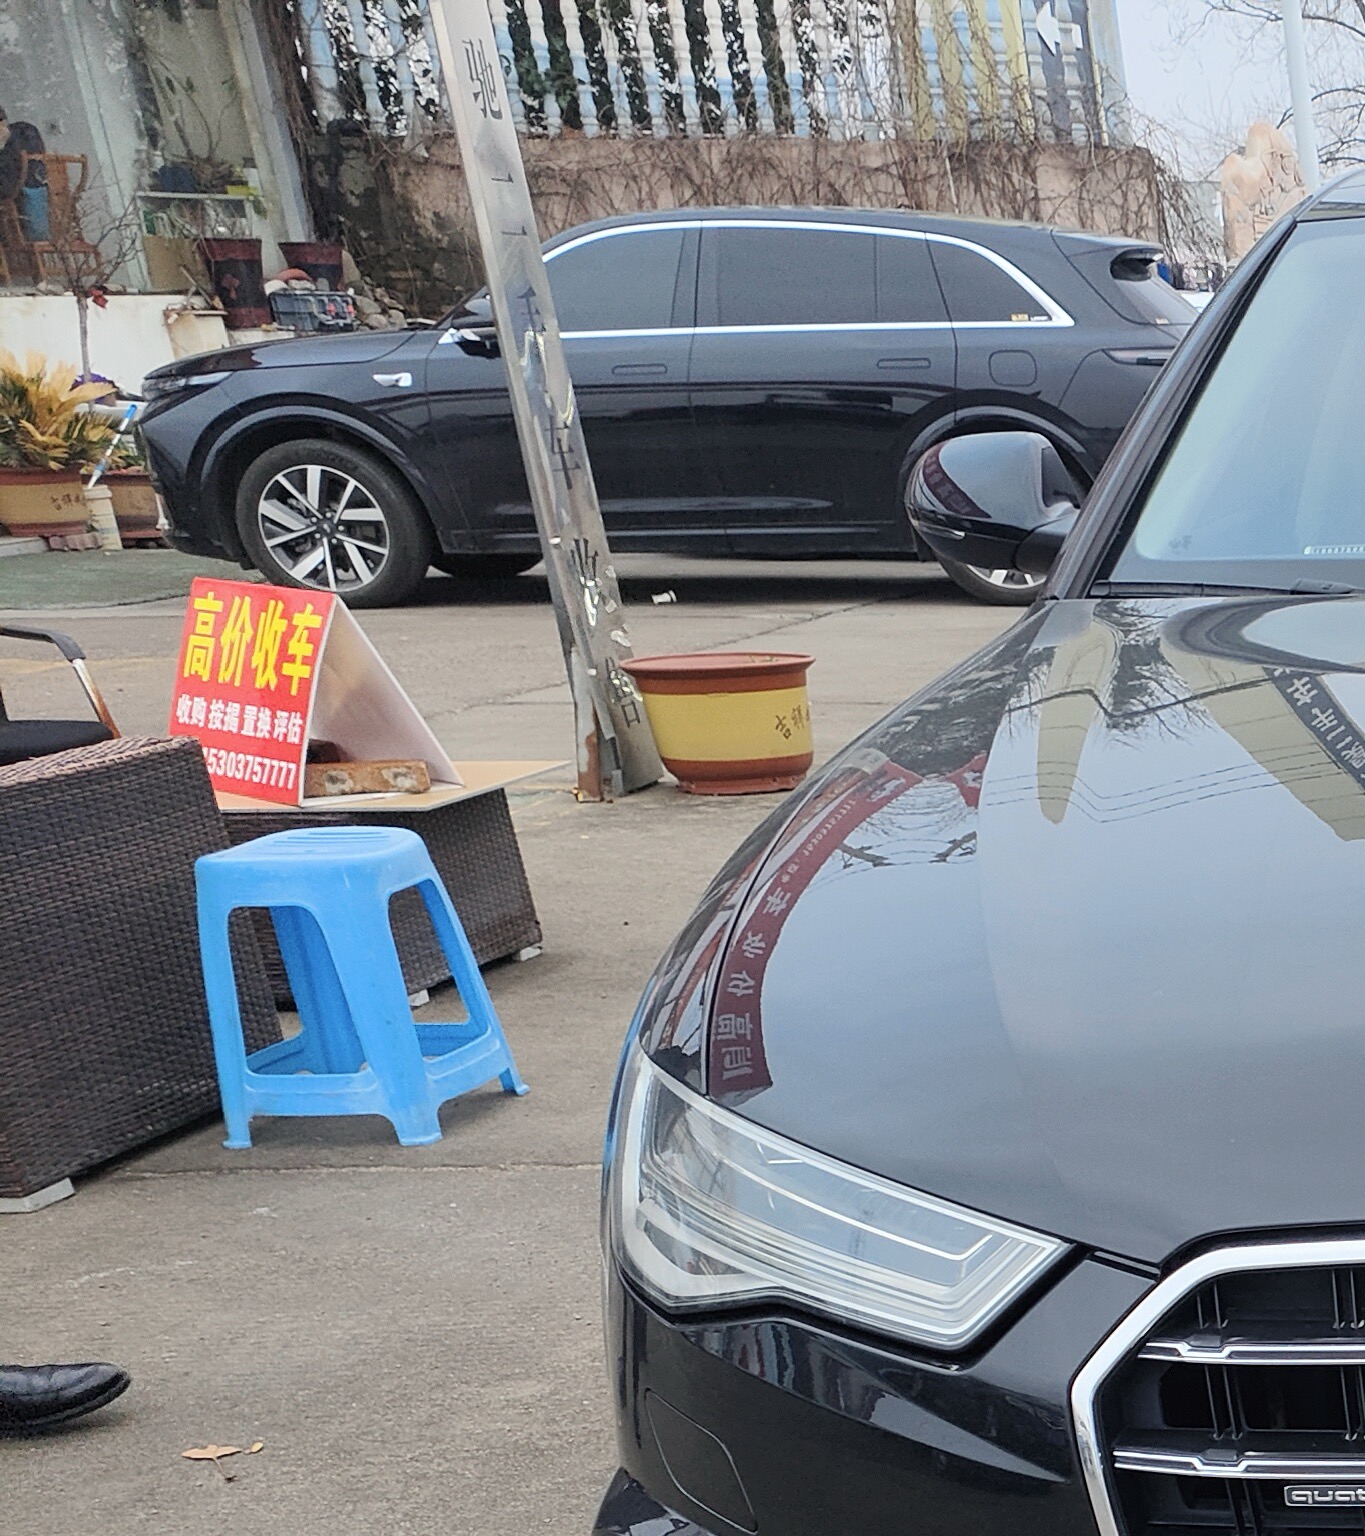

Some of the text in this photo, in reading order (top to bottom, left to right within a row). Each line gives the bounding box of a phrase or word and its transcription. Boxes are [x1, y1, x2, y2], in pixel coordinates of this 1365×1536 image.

[183, 591, 323, 697] 高价收车
[176, 693, 304, 745] 收购 按揭 置换 评估
